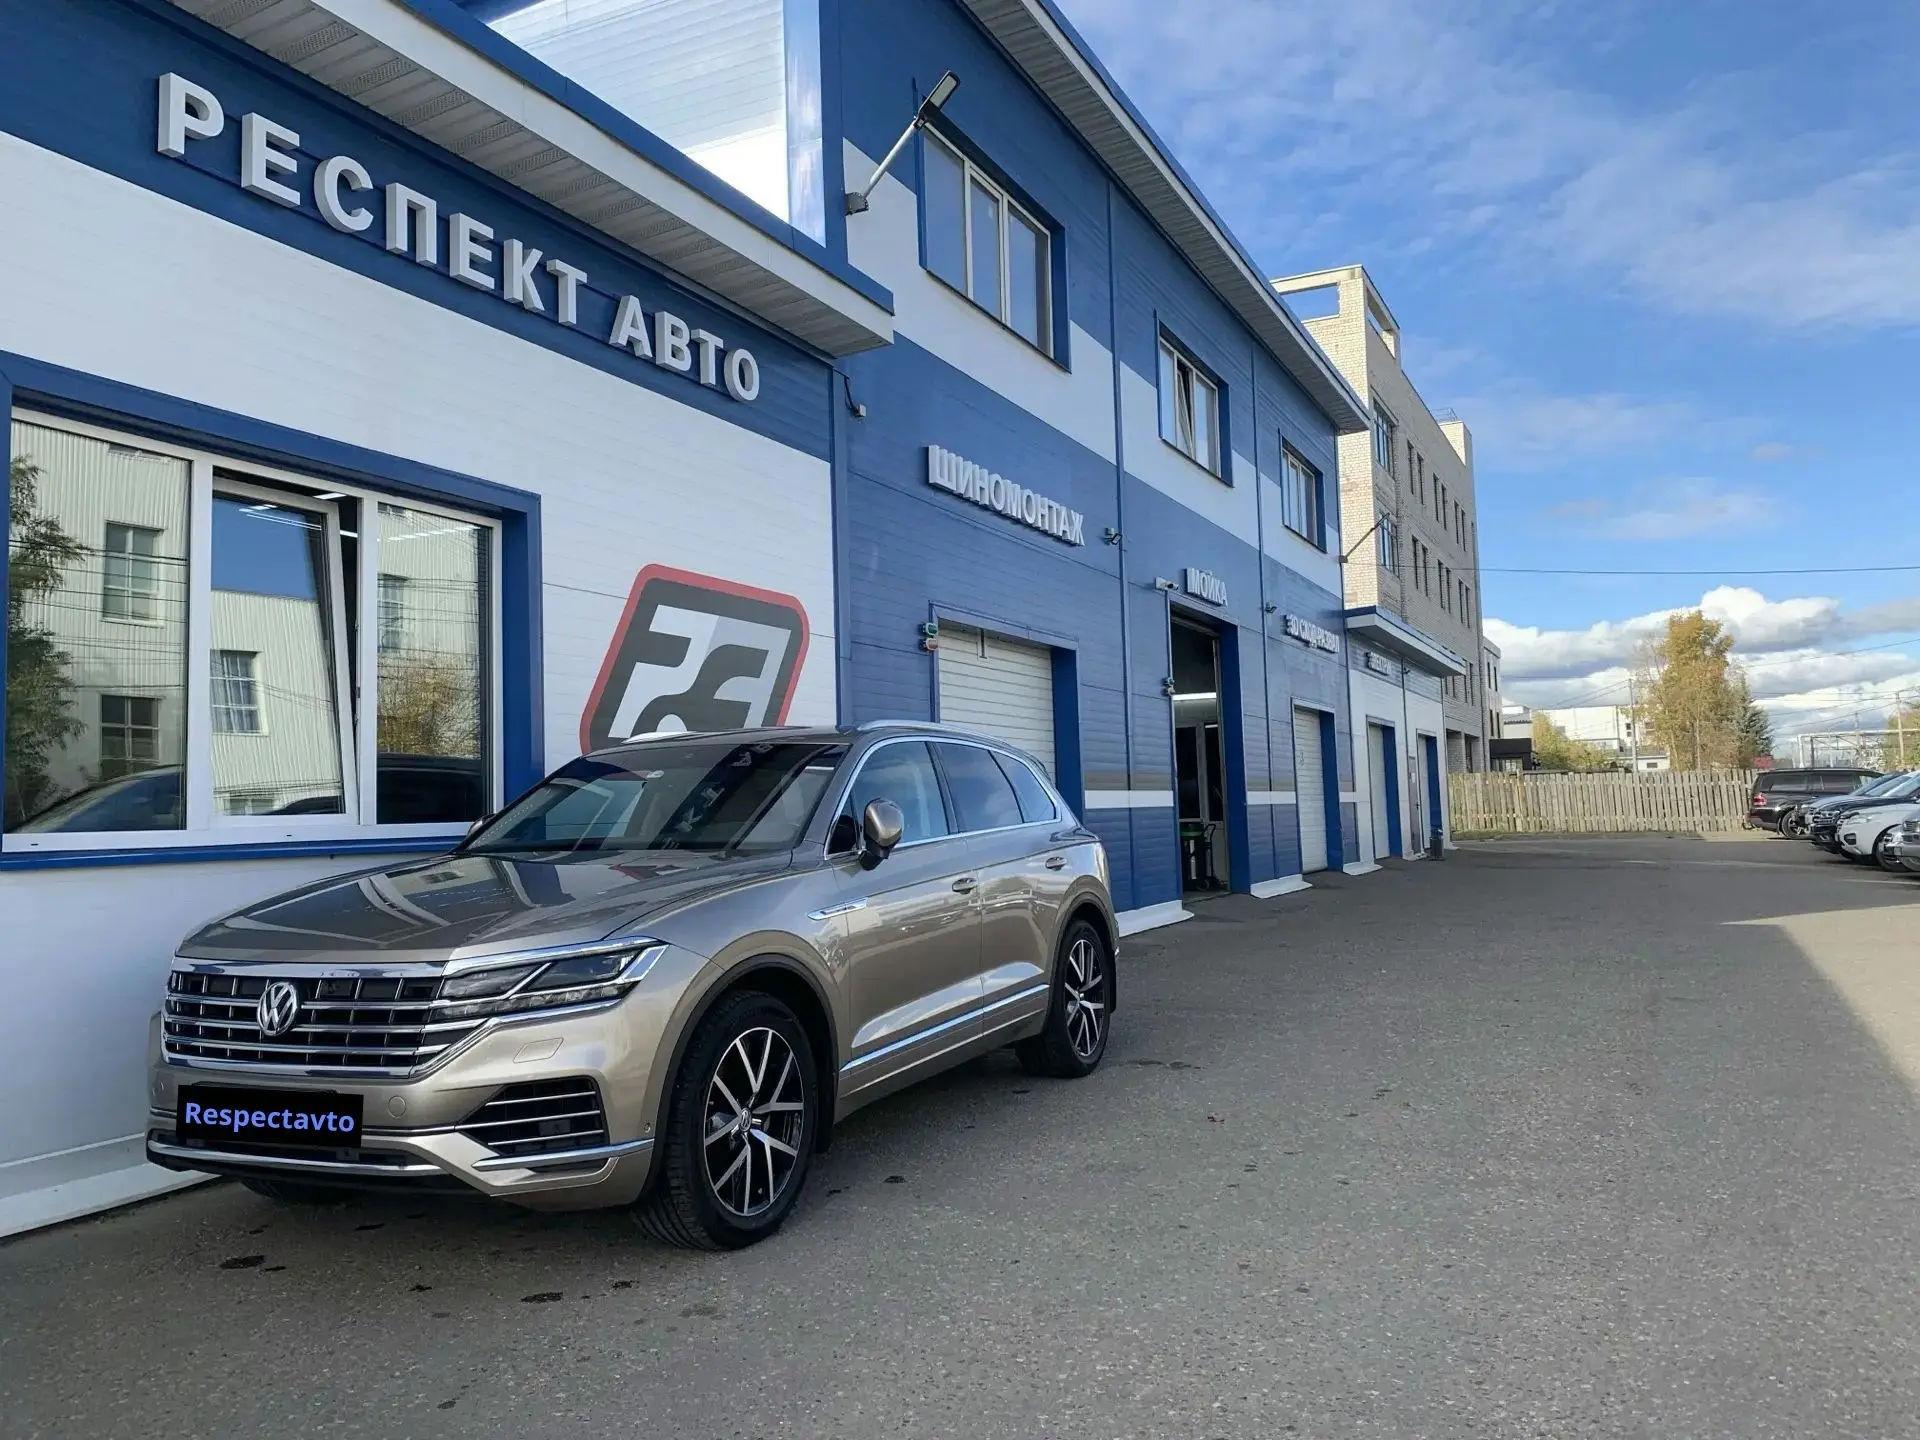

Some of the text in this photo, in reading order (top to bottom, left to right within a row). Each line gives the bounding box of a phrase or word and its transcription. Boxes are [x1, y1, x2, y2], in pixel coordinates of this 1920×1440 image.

[157, 72, 760, 402] РЕСПЕКТ АВТО
[928, 444, 1085, 547] ШИНОМОНТАЖ
[1187, 567, 1228, 606] МОЙКА
